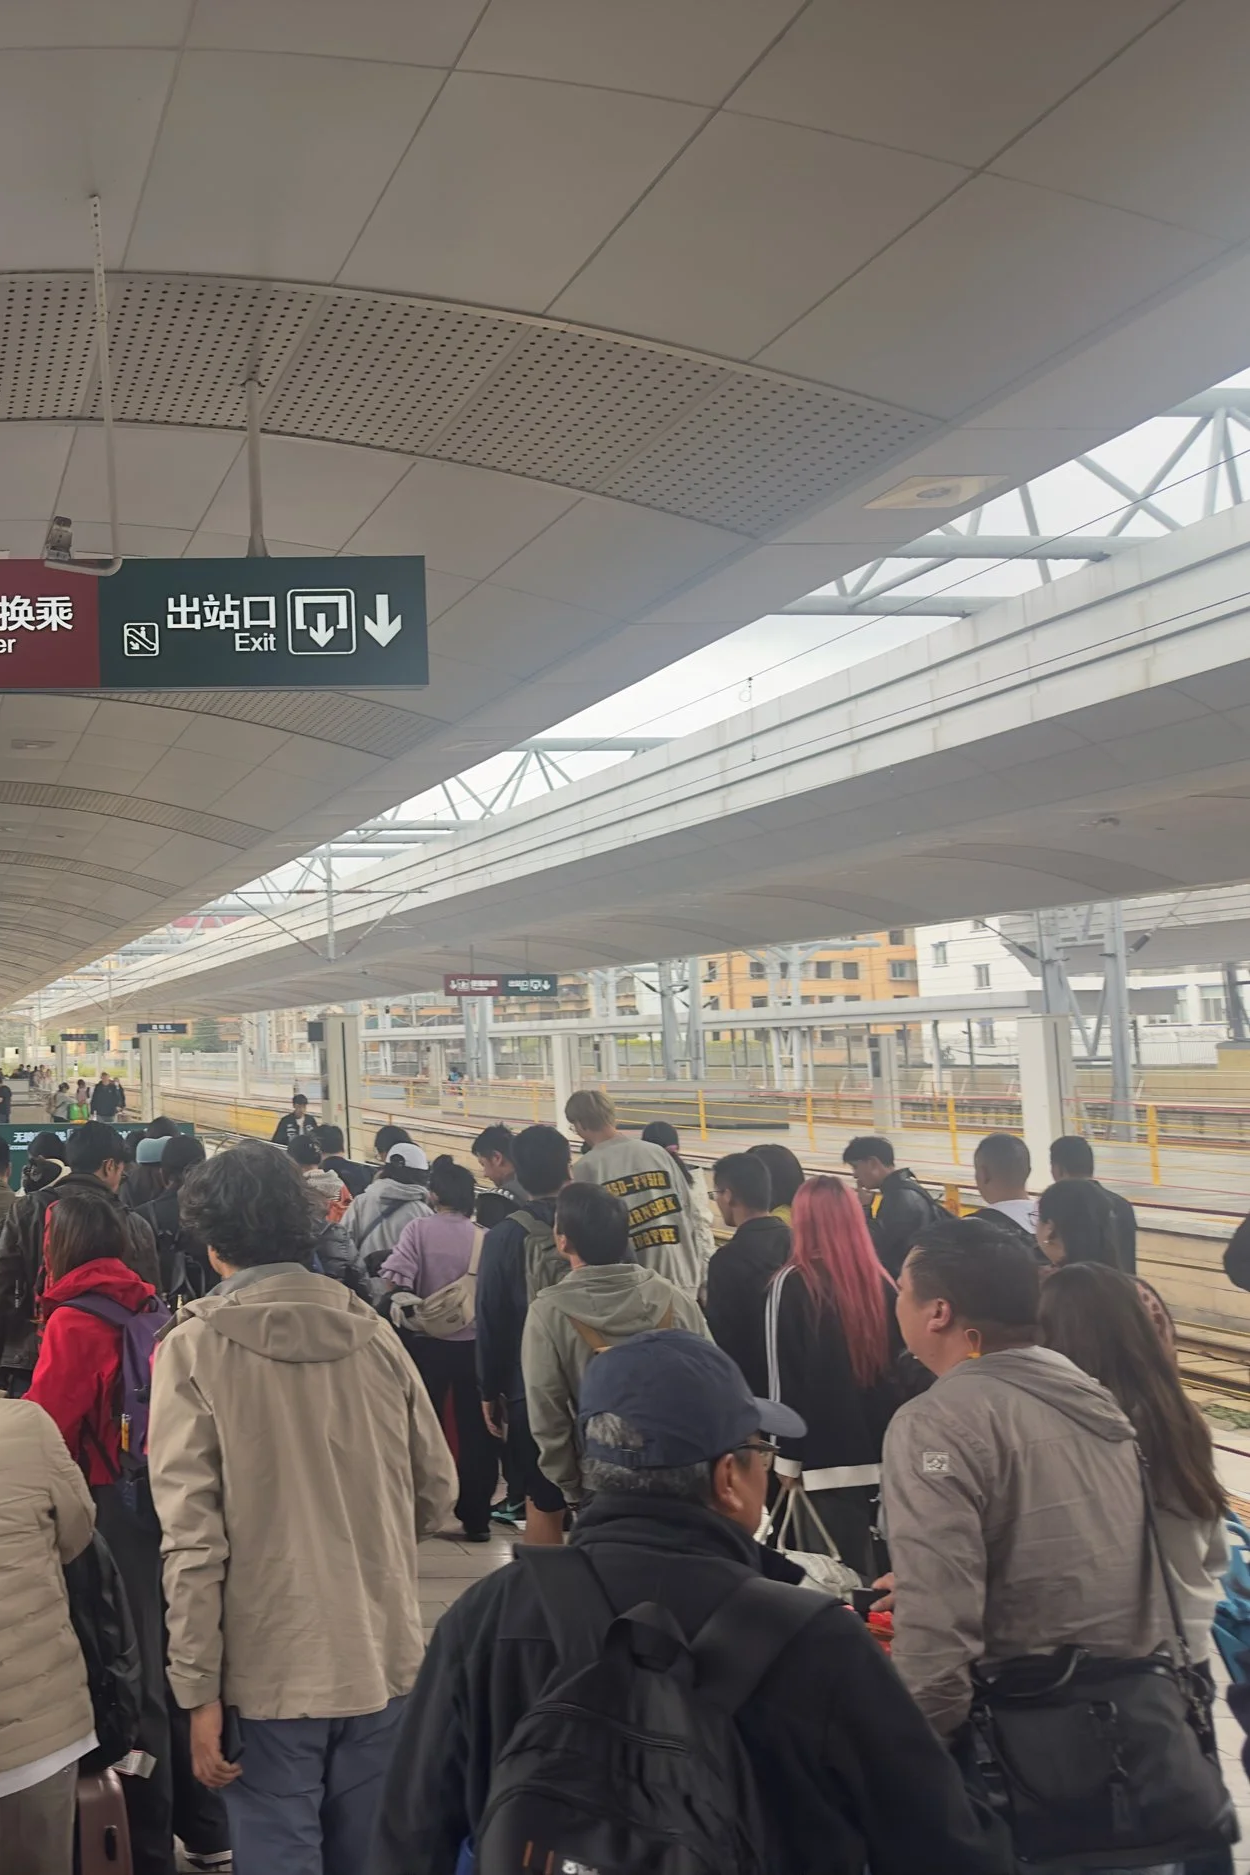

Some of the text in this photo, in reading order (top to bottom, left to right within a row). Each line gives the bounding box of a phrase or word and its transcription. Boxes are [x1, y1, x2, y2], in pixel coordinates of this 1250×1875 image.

[167, 594, 276, 630] 出站口
[235, 633, 276, 651] Exit
